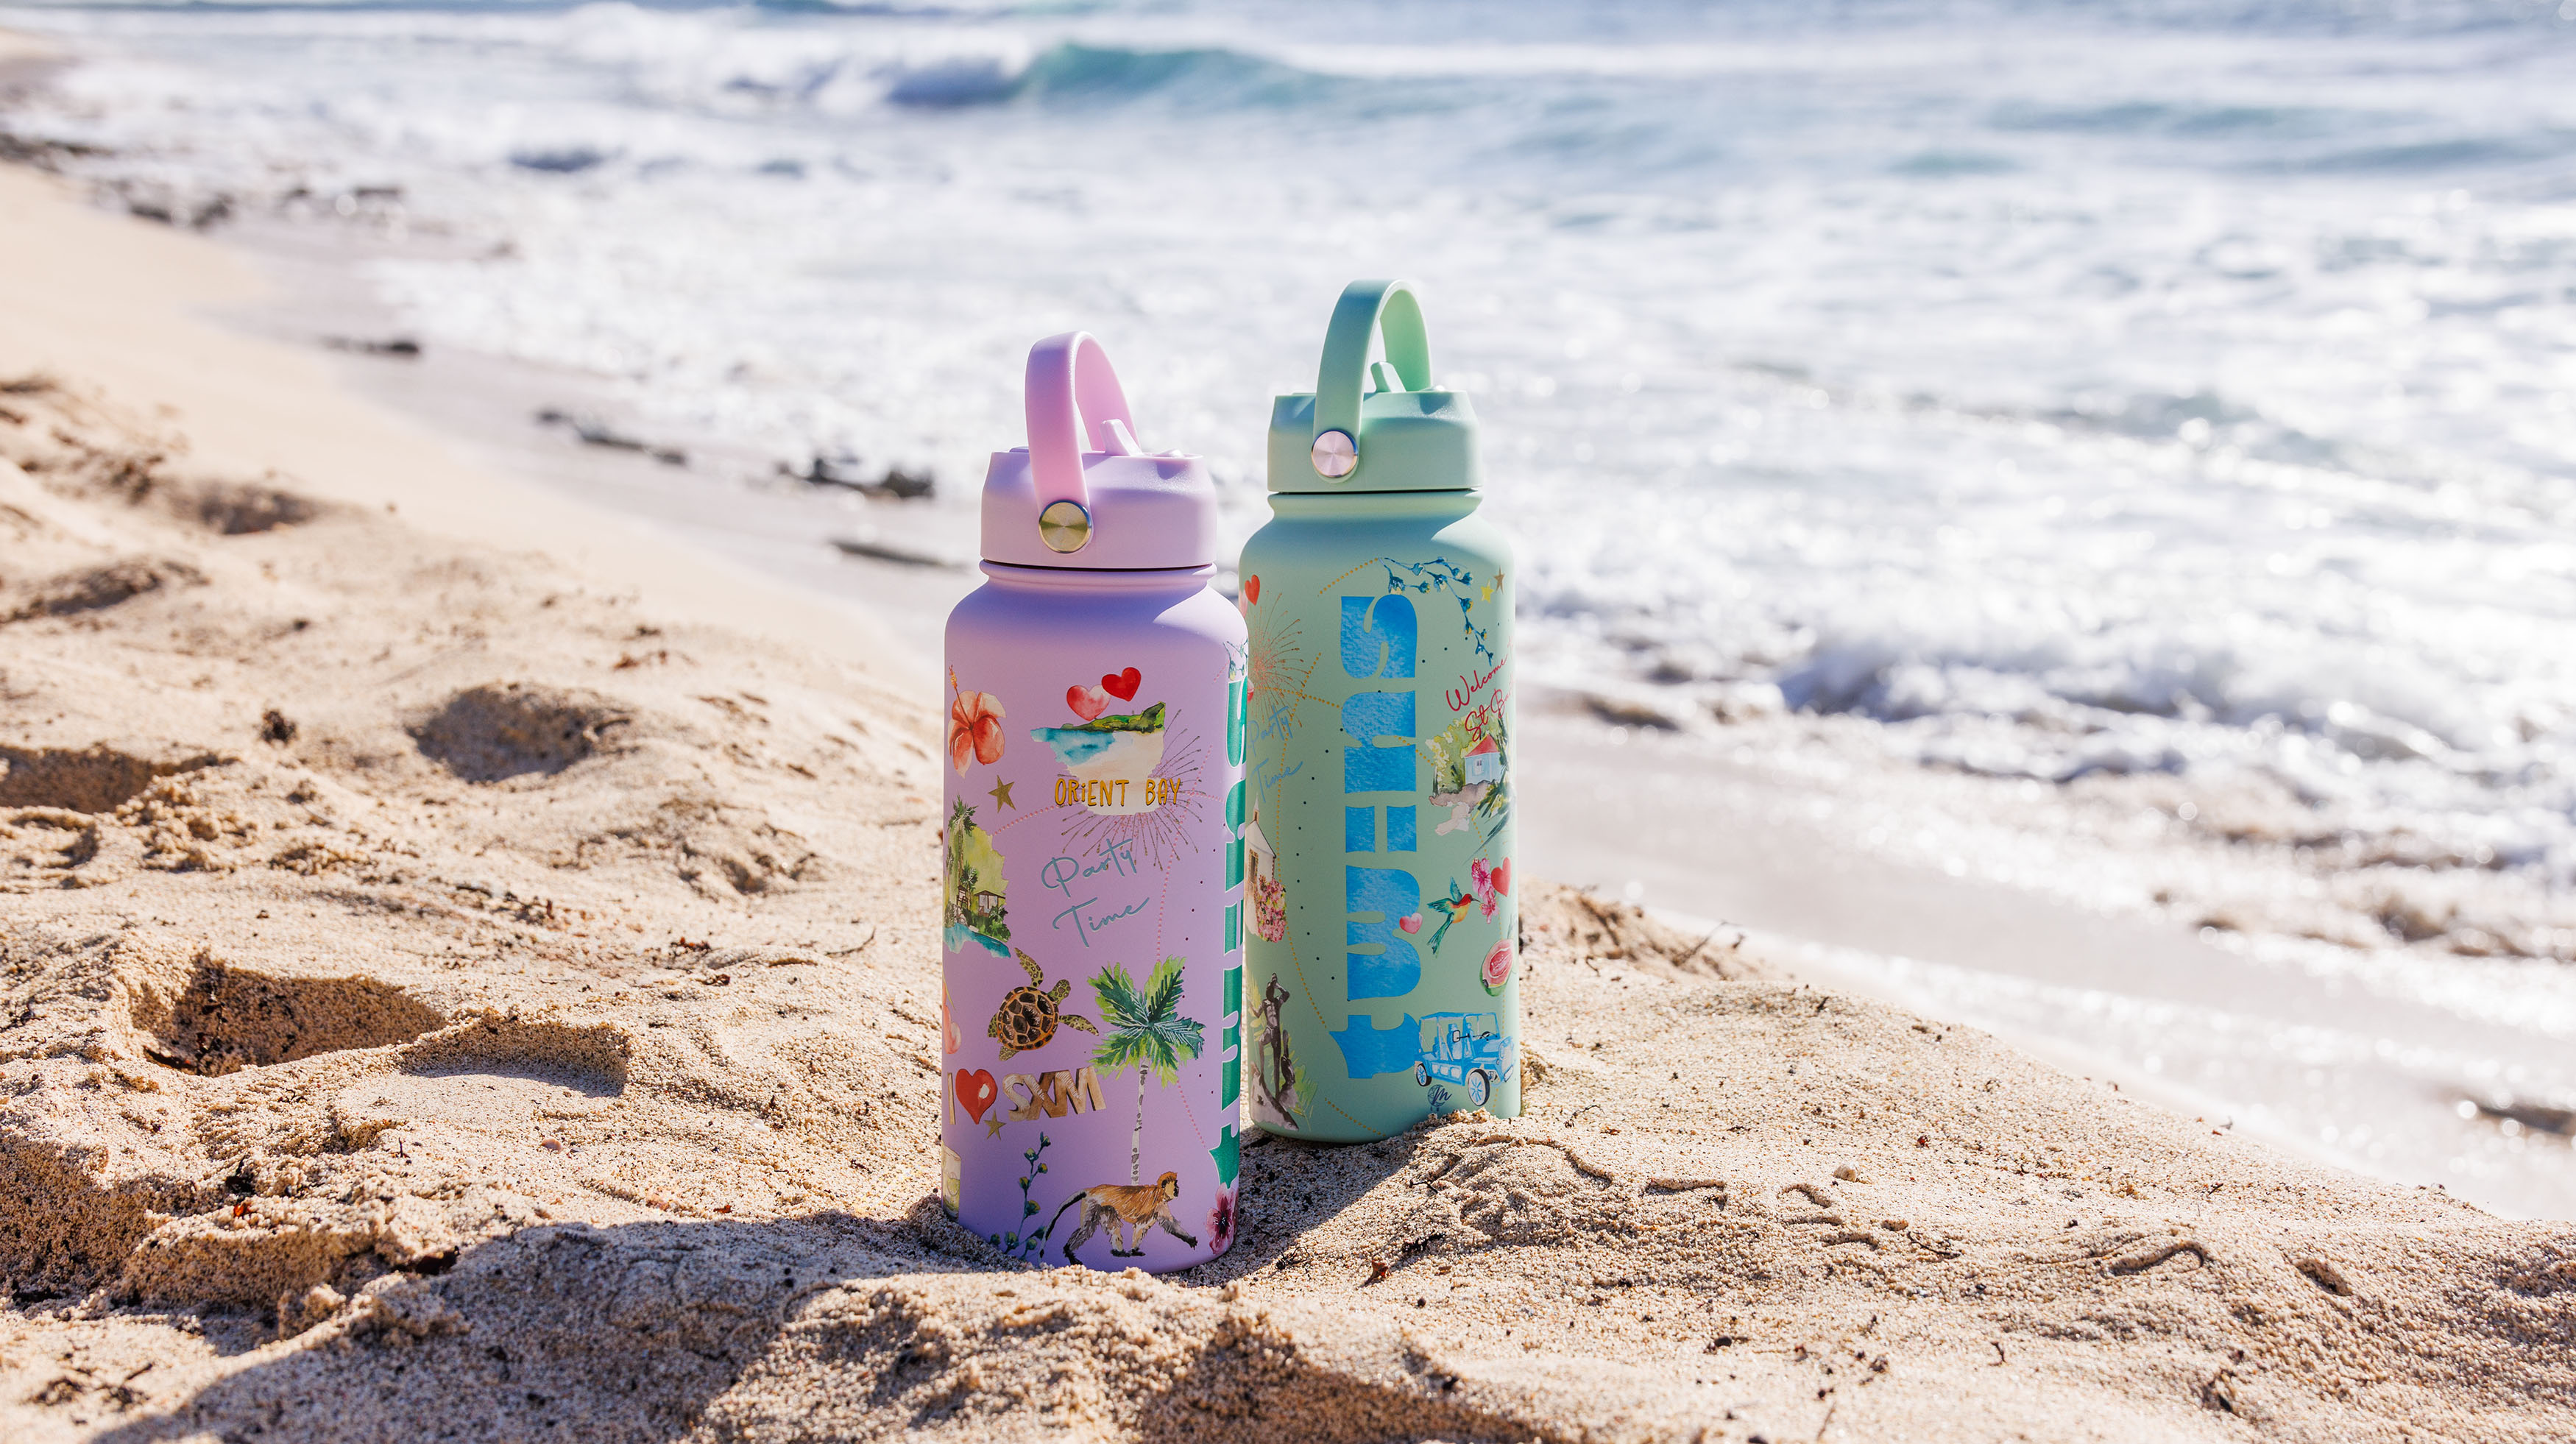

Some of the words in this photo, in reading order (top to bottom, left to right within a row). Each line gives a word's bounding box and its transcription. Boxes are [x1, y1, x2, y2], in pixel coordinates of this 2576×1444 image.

[1446, 654, 1508, 712] Welcome
[1248, 704, 1293, 757] Party
[1464, 704, 1490, 743] St
[1145, 777, 1181, 807] BAY
[1250, 758, 1303, 803] Time
[1041, 838, 1137, 897] Party
[1052, 896, 1150, 948] Time
[946, 1072, 957, 1125] I
[1002, 1064, 1107, 1122] SXM
